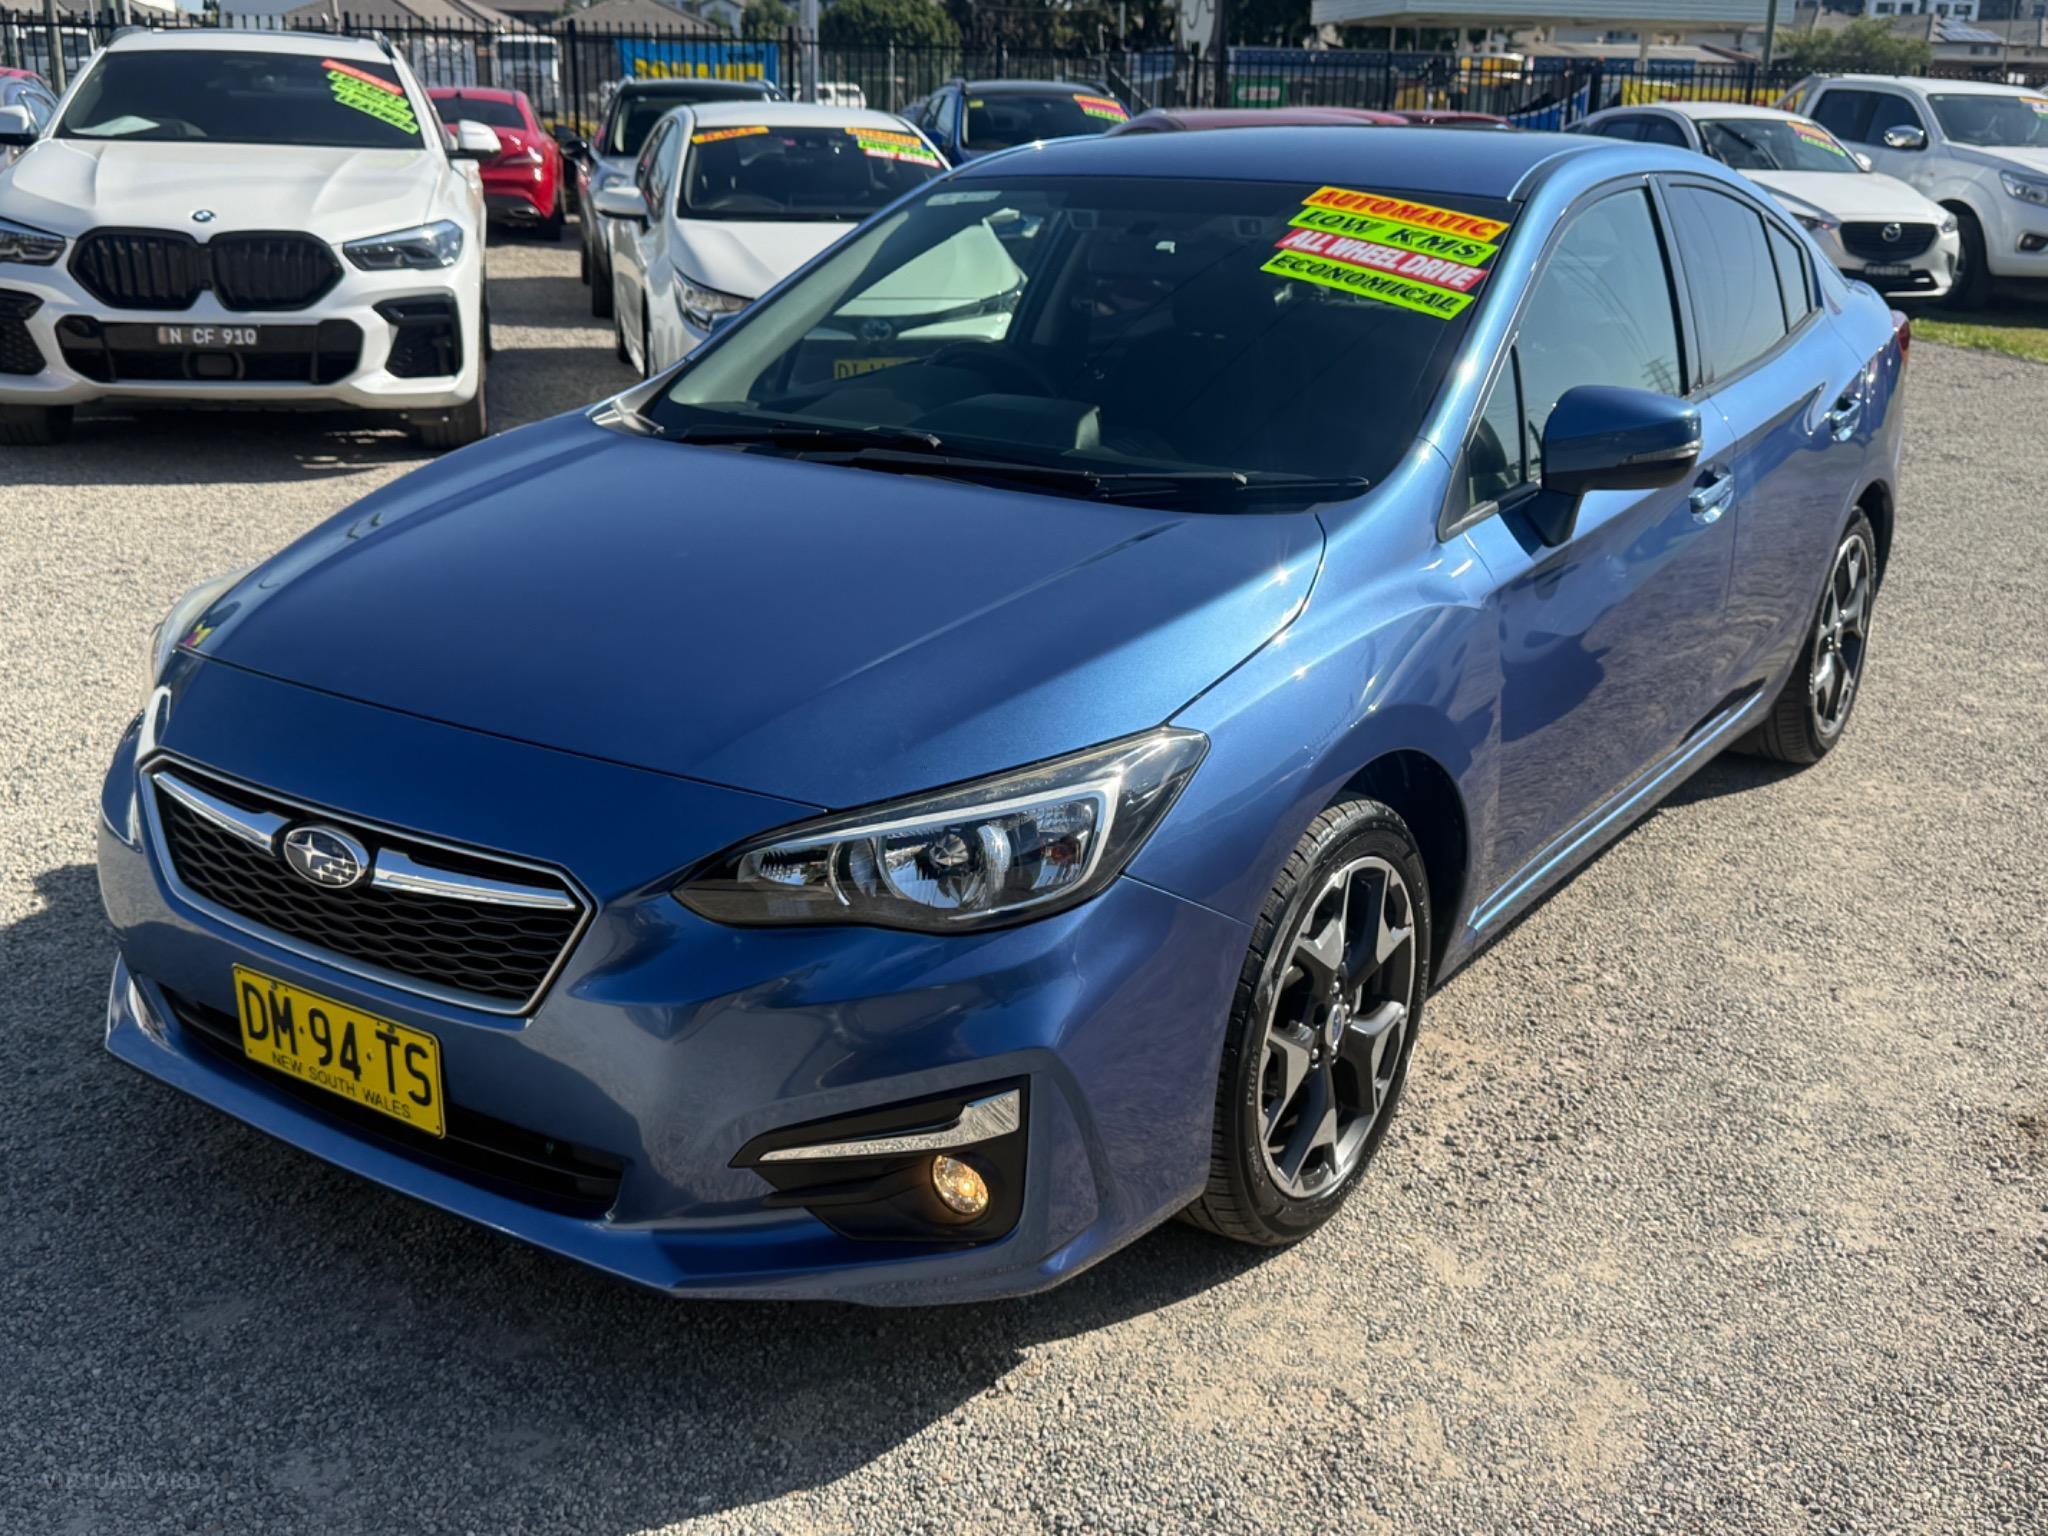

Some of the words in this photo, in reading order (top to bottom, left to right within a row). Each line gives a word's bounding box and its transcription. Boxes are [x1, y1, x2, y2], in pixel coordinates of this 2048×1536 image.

[1300, 210, 1383, 234] LOW
[1385, 227, 1486, 260] KMS
[1309, 190, 1501, 238] AUTOMATIC
[1271, 253, 1462, 313] ECONOMICAL
[1285, 229, 1327, 251] ALL
[1324, 237, 1405, 270] WHEEL
[1398, 253, 1481, 288] DRIVE
[272, 1051, 303, 1074] NEW
[308, 1066, 355, 1093] SOUTH
[362, 1087, 412, 1119] WALES
